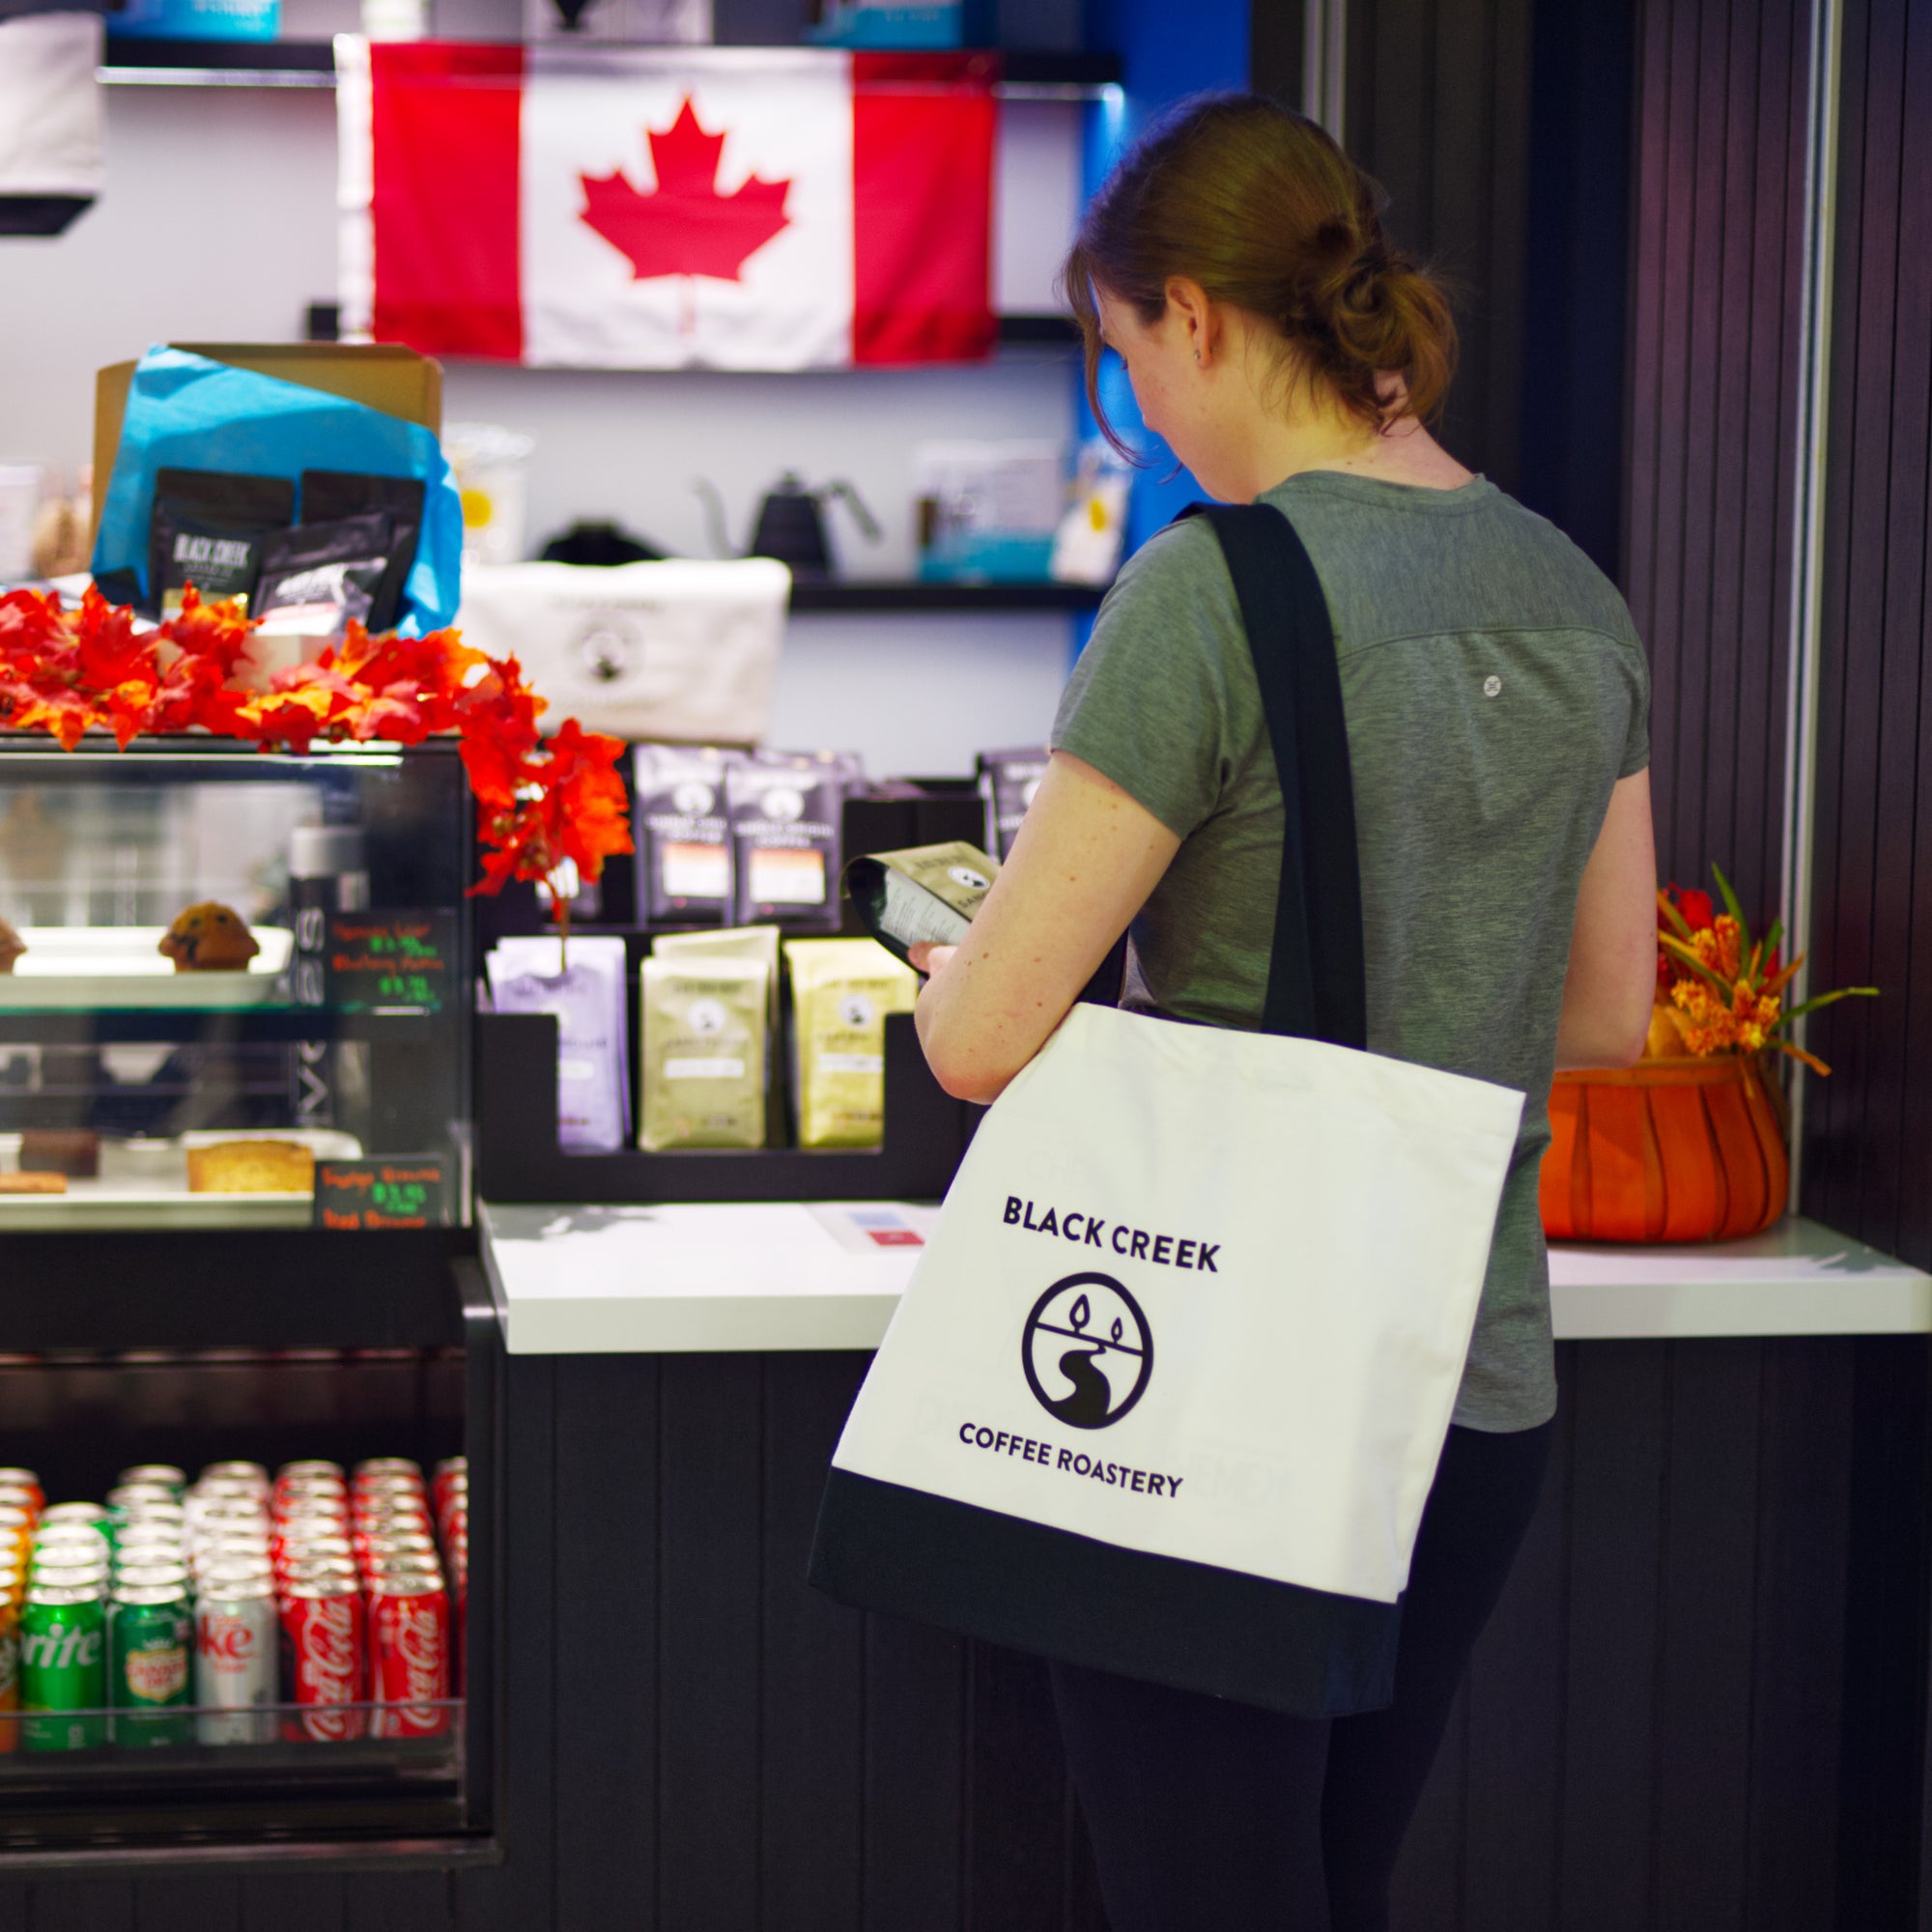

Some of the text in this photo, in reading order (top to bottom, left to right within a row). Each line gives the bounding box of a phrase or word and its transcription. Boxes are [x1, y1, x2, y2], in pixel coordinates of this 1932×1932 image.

[1003, 1195, 1221, 1273] BLACK CREEK
[958, 1422, 1053, 1466] COFFEE
[1057, 1448, 1184, 1499] ROASTERY
[22, 1622, 101, 1669] rite
